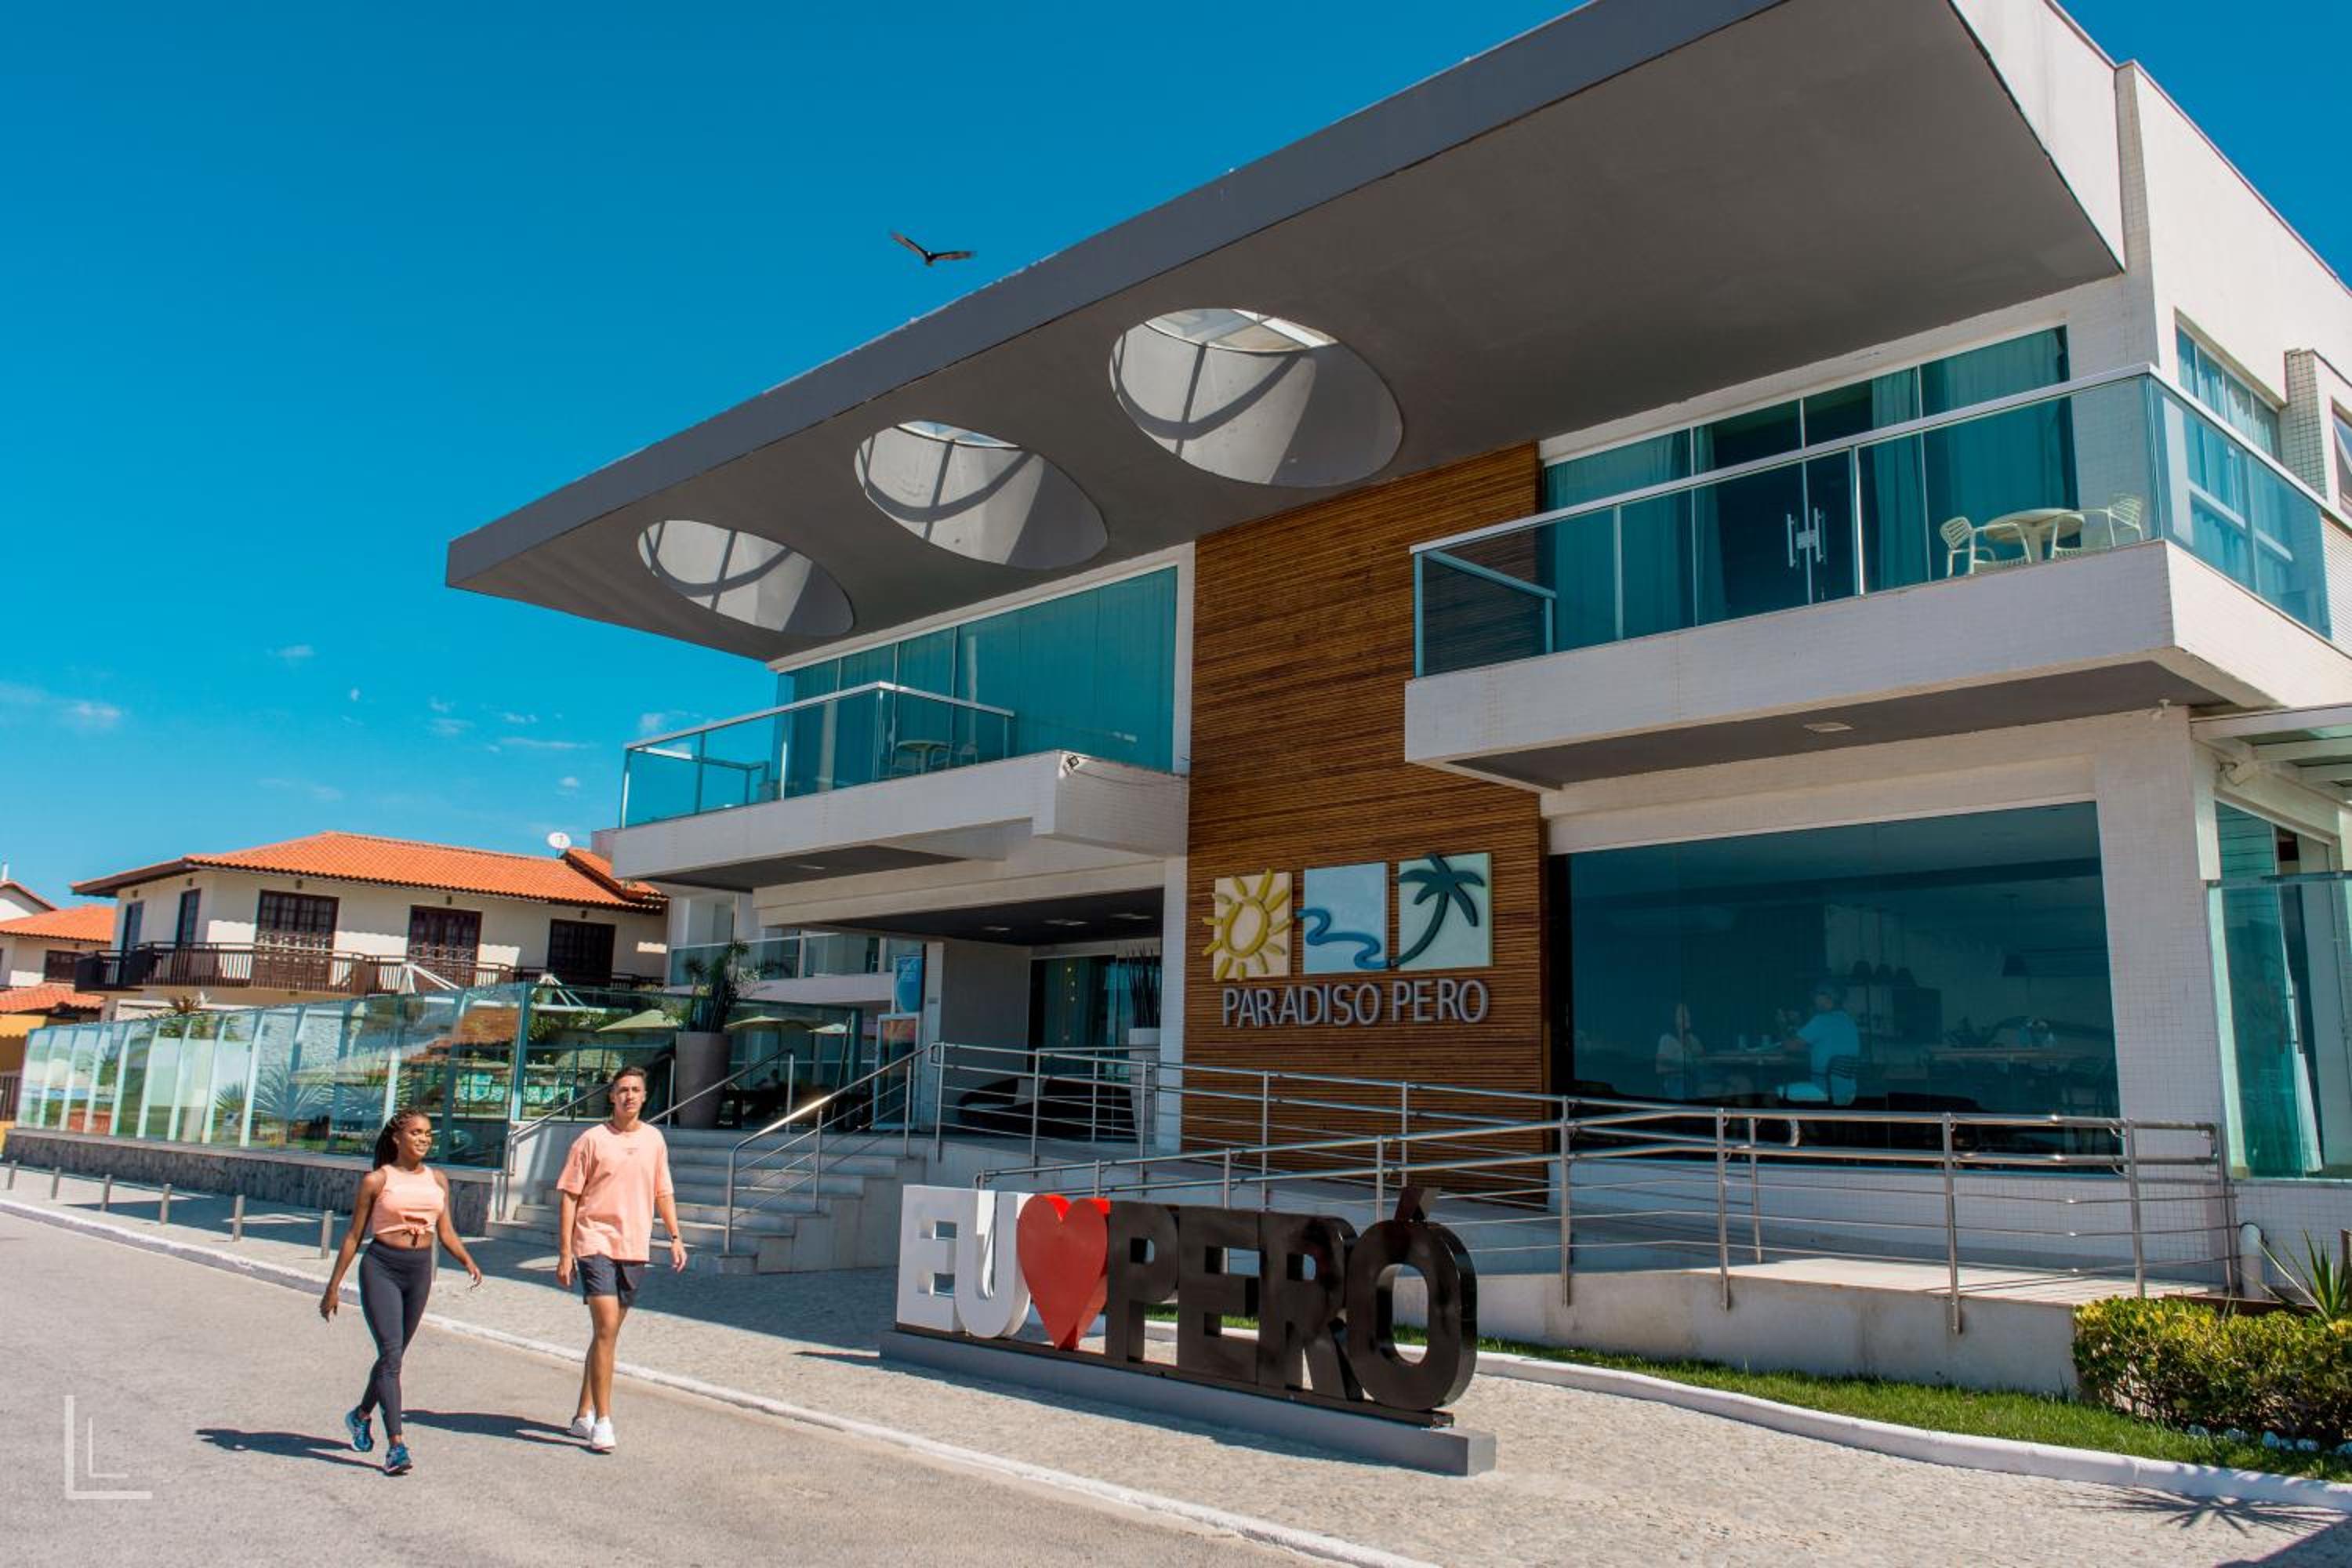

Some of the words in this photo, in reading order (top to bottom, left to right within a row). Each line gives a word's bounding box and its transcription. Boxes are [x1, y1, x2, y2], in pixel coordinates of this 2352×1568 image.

[1222, 984, 1382, 1028] PARADISO
[1392, 978, 1489, 1023] PERO
[896, 1185, 1030, 1338] EU
[1106, 1187, 1477, 1410] PERÓ
